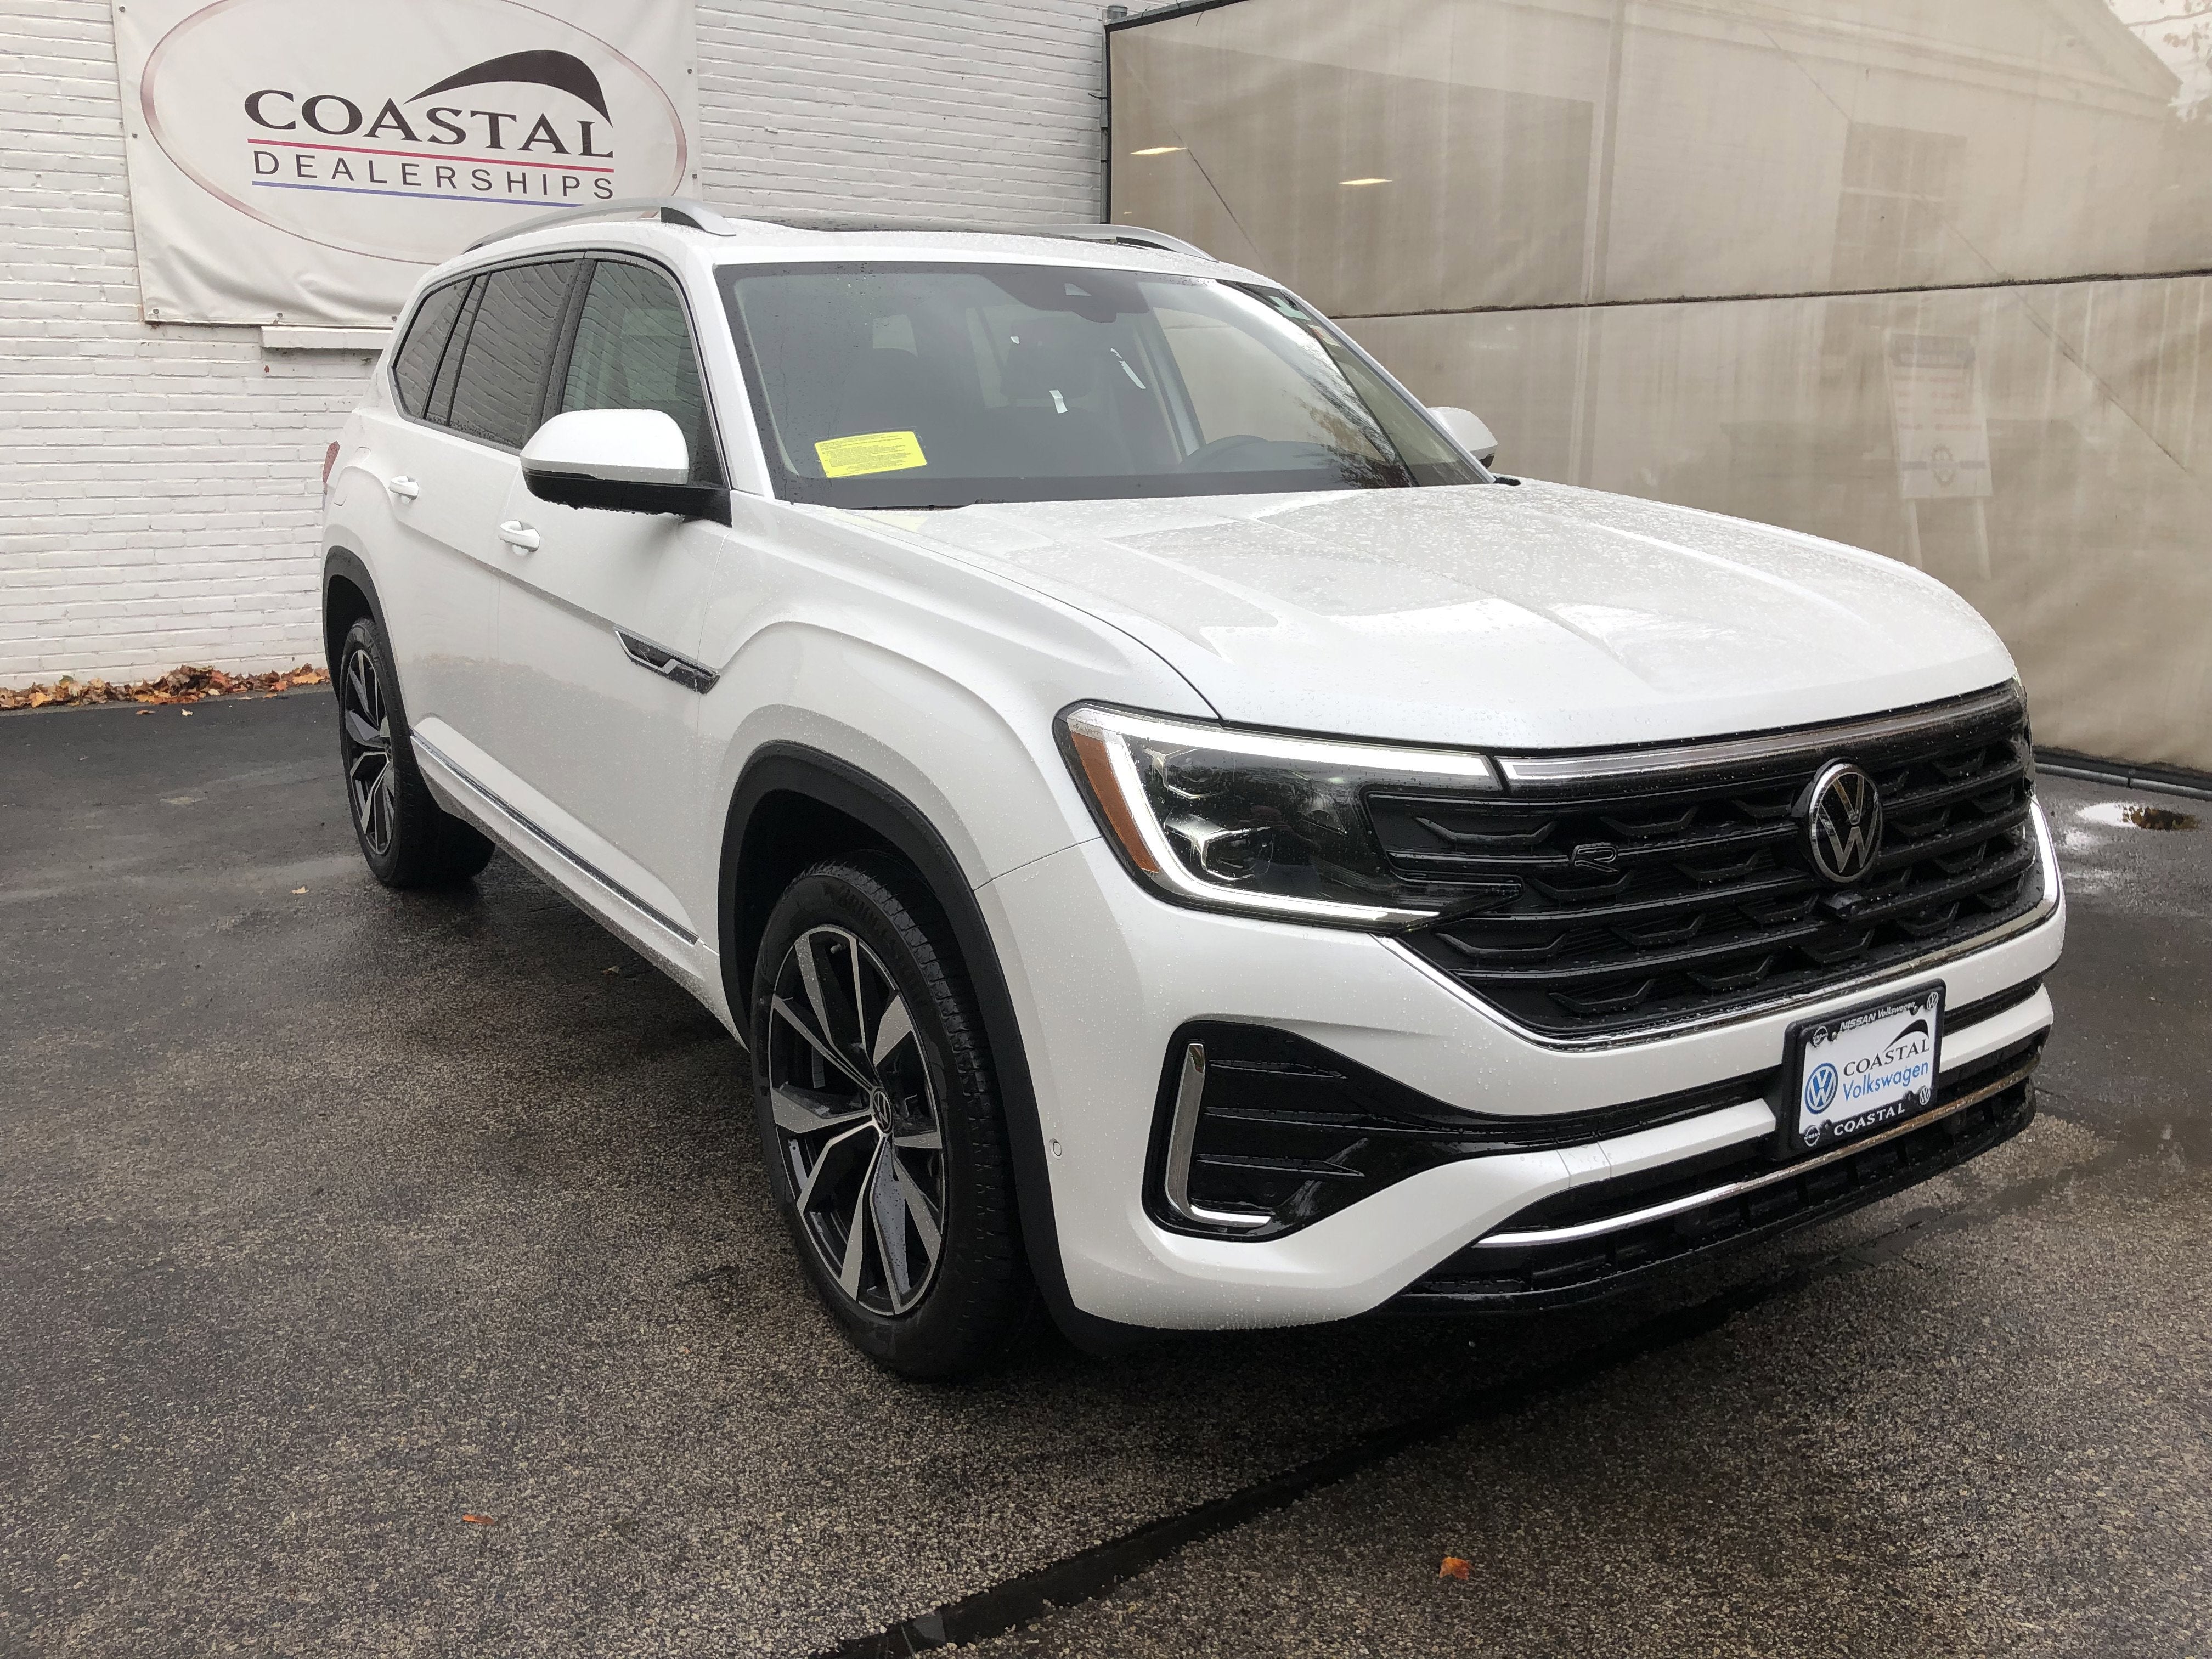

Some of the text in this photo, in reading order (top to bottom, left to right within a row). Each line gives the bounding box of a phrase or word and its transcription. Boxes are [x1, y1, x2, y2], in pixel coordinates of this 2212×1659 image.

[244, 89, 614, 159] COASTAL
[253, 150, 614, 200] DEALERSHIPS
[1570, 842, 1619, 872] R
[1840, 1012, 1876, 1031] NISSAN
[1843, 1039, 1930, 1076] COASTAL
[1805, 1062, 1838, 1114] VW
[1843, 1062, 1928, 1102] Volkswagen
[1834, 1103, 1905, 1136] COASTAL
